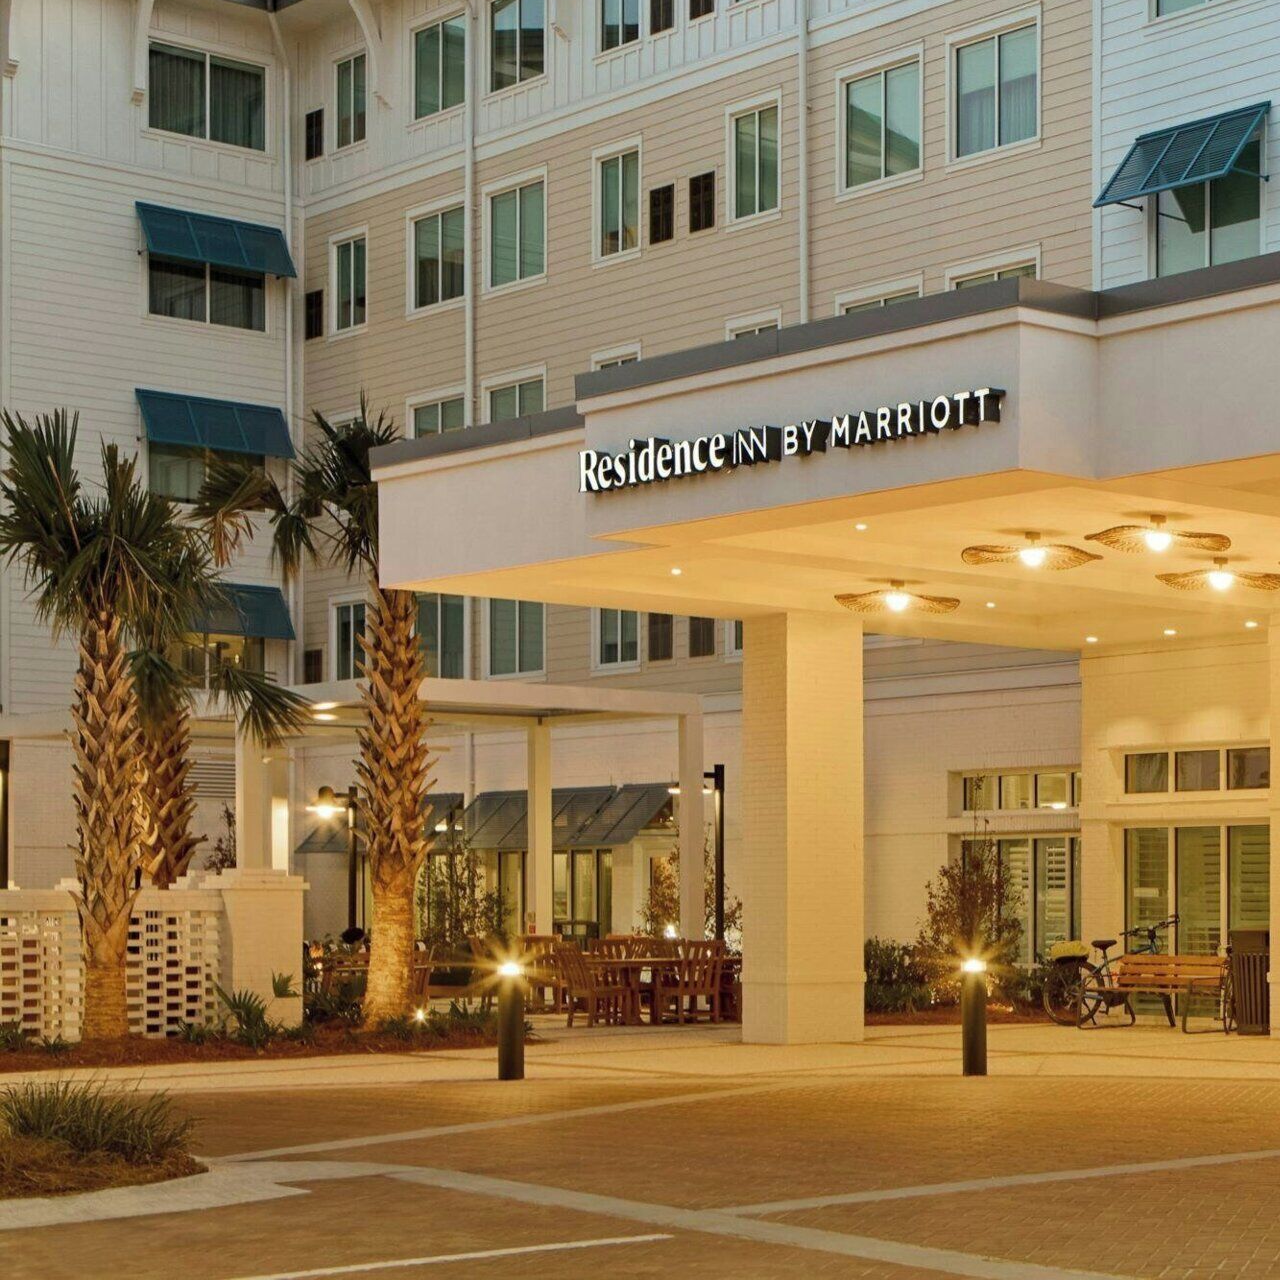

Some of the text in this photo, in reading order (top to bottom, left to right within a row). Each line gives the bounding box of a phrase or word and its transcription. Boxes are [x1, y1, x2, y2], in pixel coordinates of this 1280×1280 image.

[578, 387, 991, 493] Residence INN BY MARRIOTT
